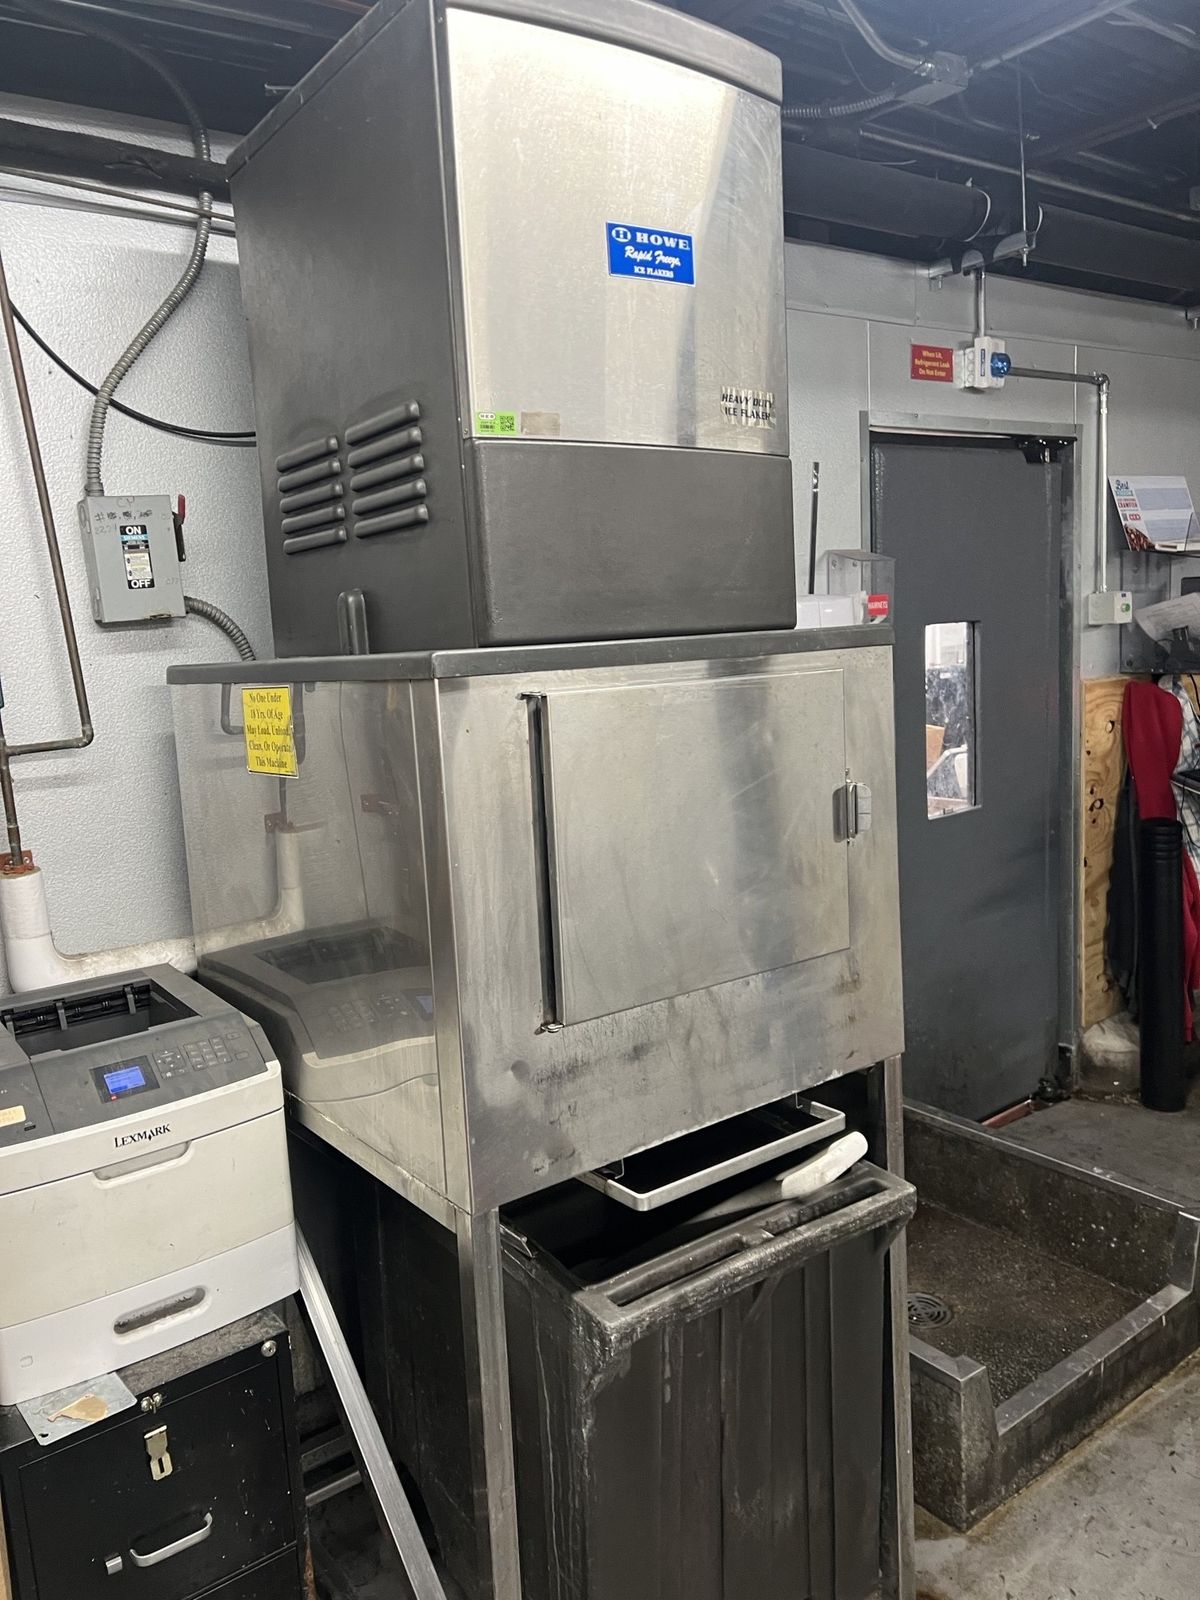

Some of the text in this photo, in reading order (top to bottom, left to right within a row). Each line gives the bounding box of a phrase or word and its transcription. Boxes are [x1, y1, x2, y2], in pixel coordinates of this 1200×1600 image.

[636, 232, 690, 250] HOWE
[625, 246, 653, 262] Rapid
[634, 266, 674, 278] ICE FLAKERS
[721, 393, 773, 408] HEAVY DUTY
[725, 407, 771, 420] ICE FLAKER
[125, 526, 142, 535] ON
[130, 579, 151, 588] OFF
[249, 693, 282, 703] No One Under
[250, 710, 256, 719] 18
[267, 709, 274, 719] Of
[274, 710, 283, 722] Age
[246, 725, 257, 737] May
[263, 742, 271, 751] Or
[255, 756, 288, 769] This Machine
[114, 1123, 171, 1149] LEXMARK
